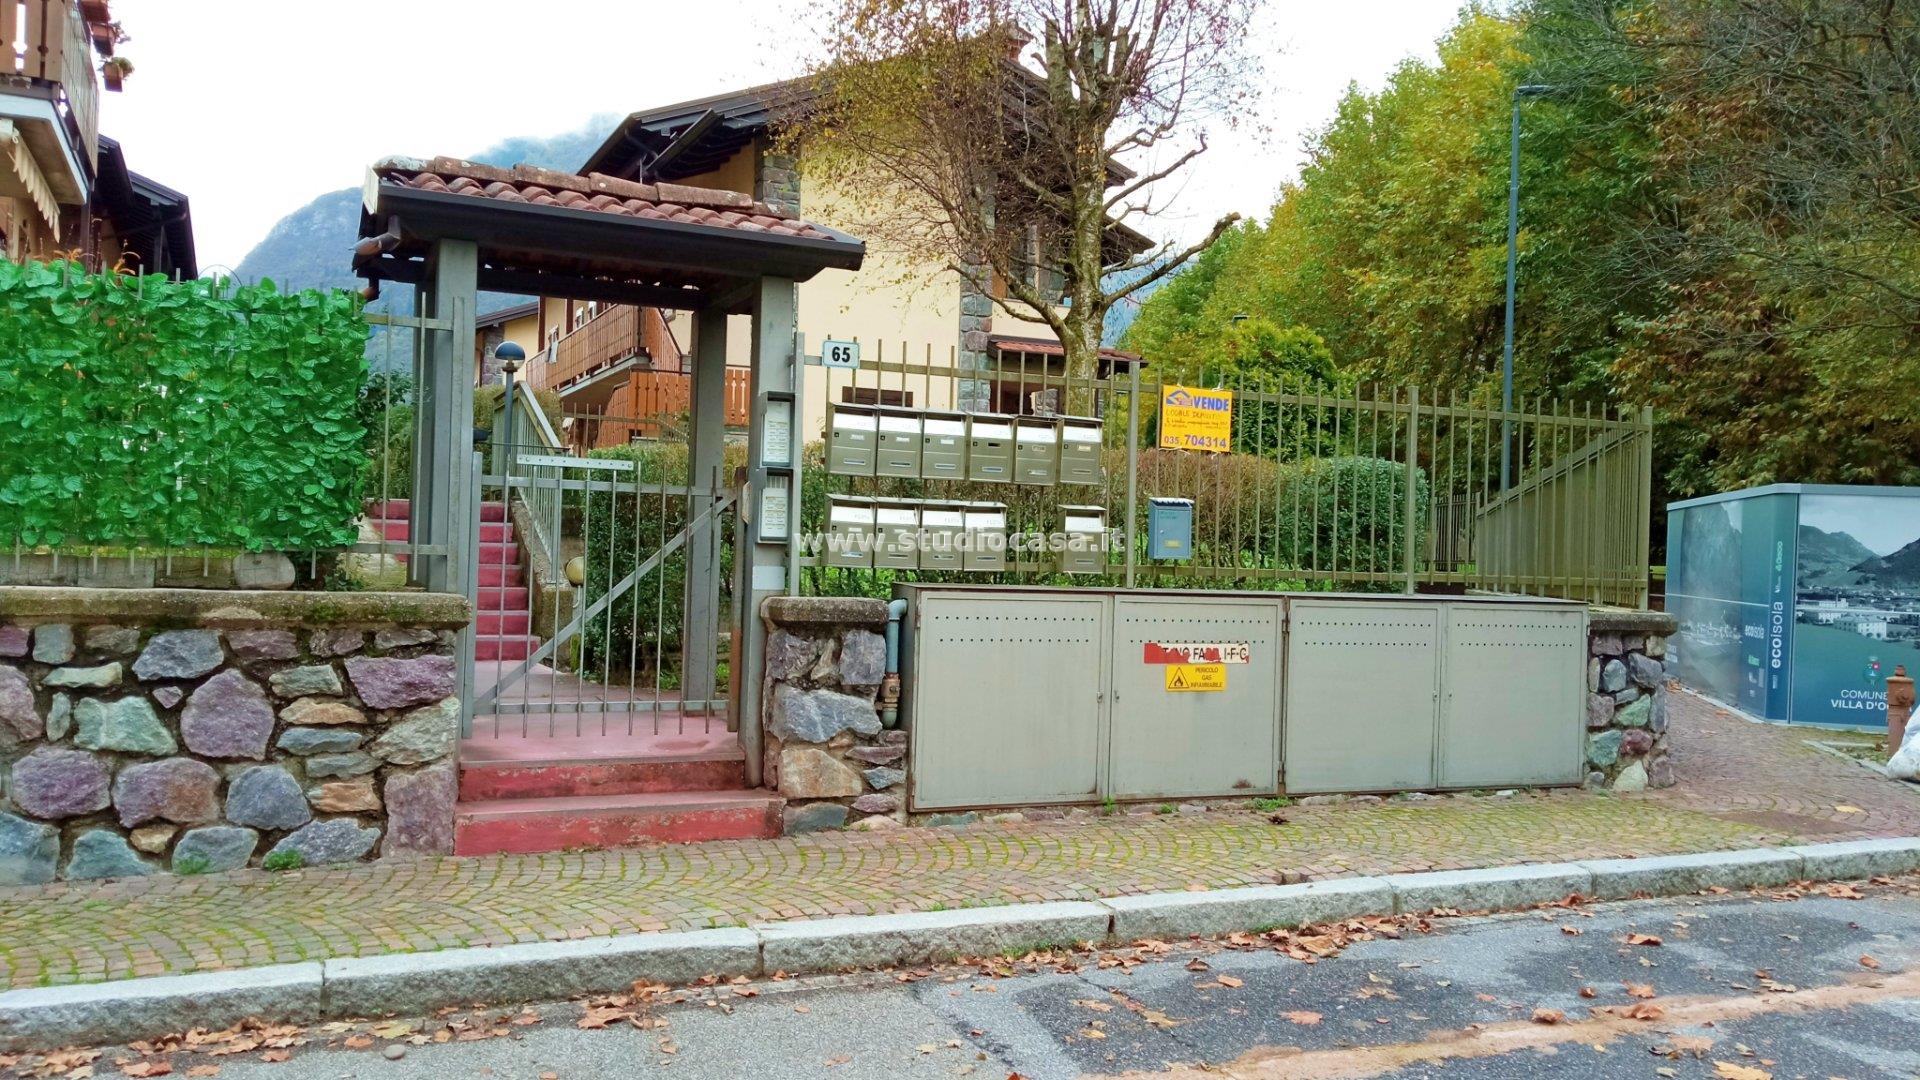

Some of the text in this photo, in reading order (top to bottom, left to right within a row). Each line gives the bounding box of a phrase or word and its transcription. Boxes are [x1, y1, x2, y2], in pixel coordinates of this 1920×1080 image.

[832, 346, 851, 363] 65
[1193, 396, 1229, 411] VENDE
[1771, 601, 1784, 670] ecoisola
[1840, 690, 1889, 701] COMUNE
[1831, 699, 1864, 710] VILLA
